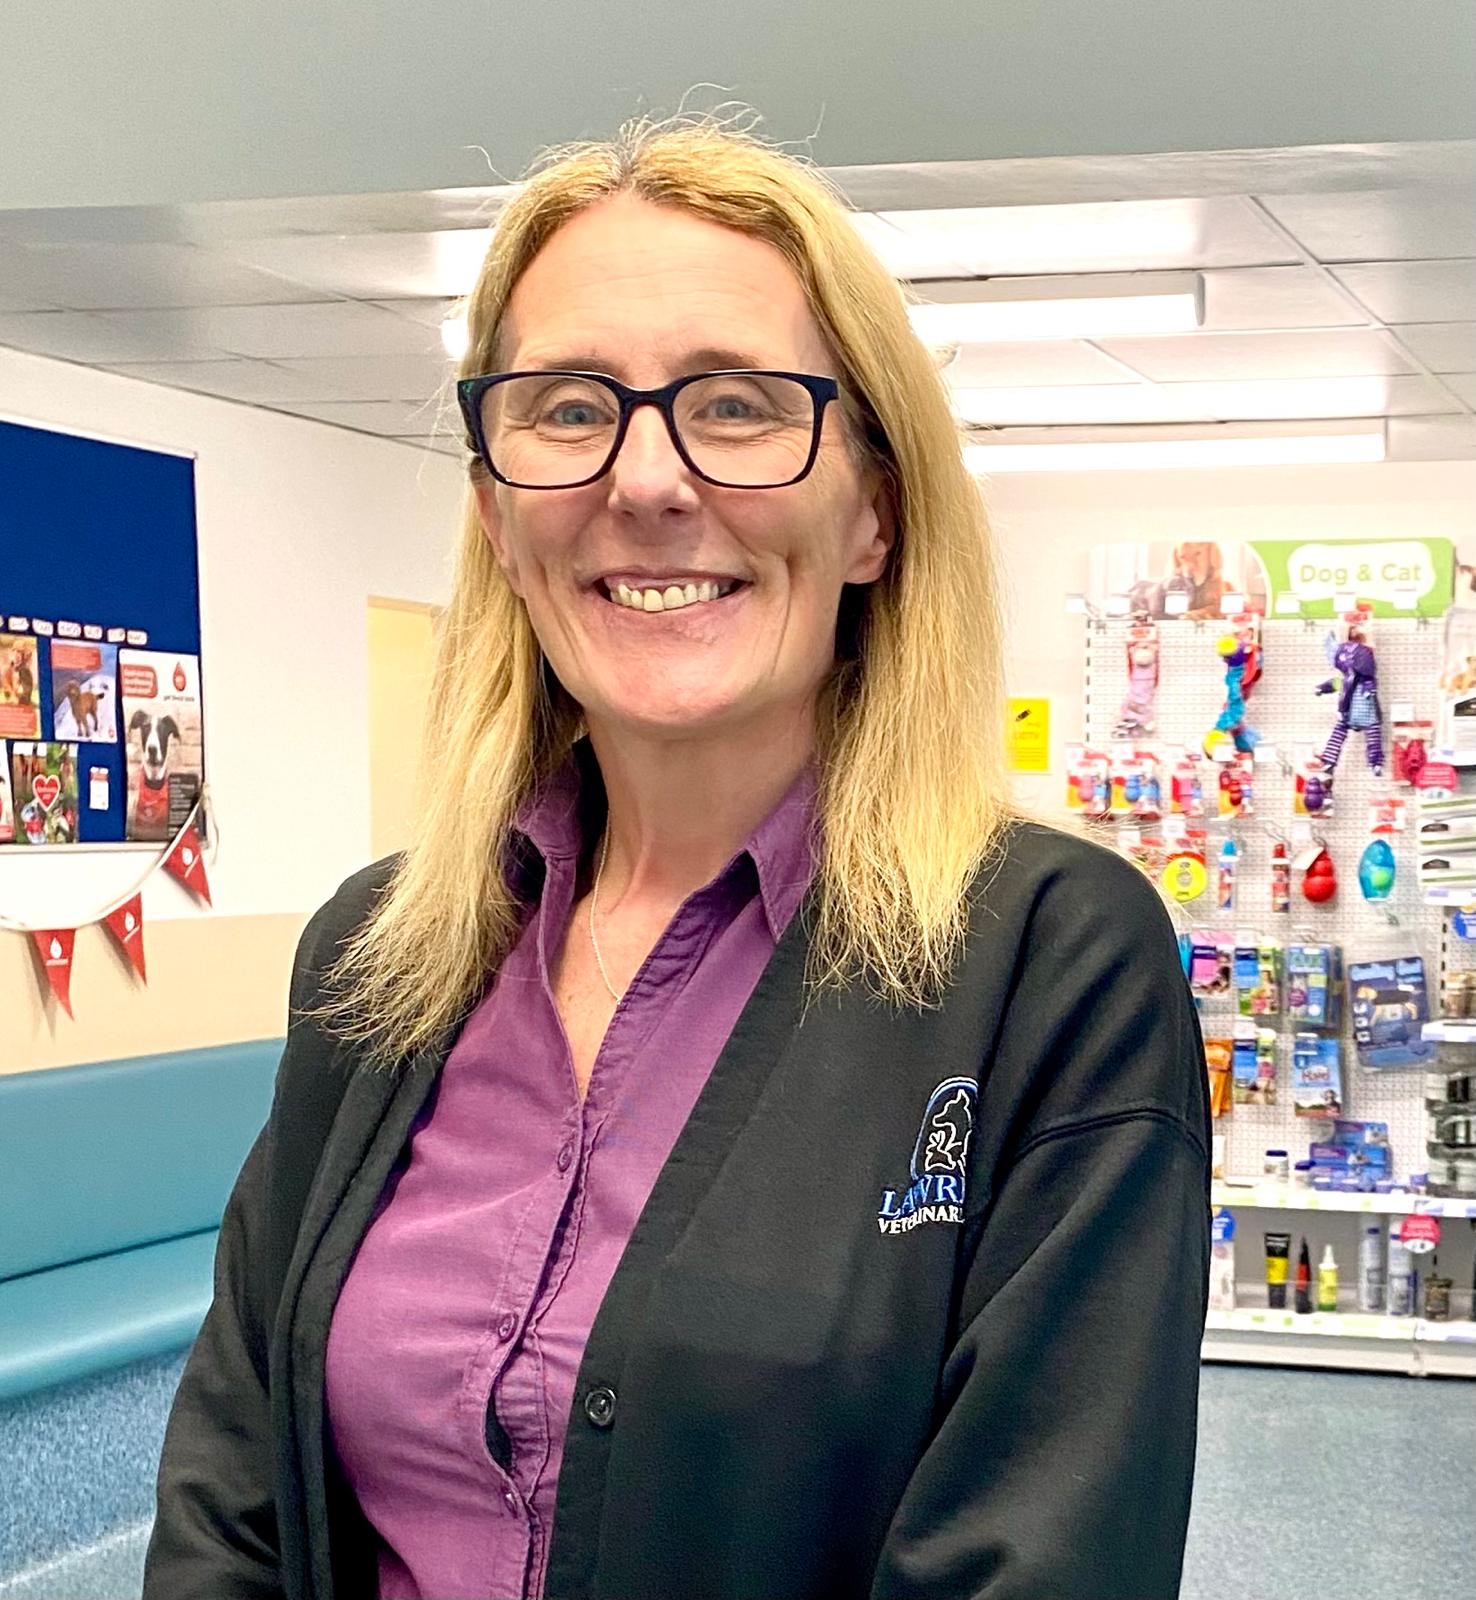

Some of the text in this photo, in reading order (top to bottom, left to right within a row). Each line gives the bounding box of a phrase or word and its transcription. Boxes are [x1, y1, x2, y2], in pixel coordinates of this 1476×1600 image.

[1301, 562, 1422, 586] Dog & Cat
